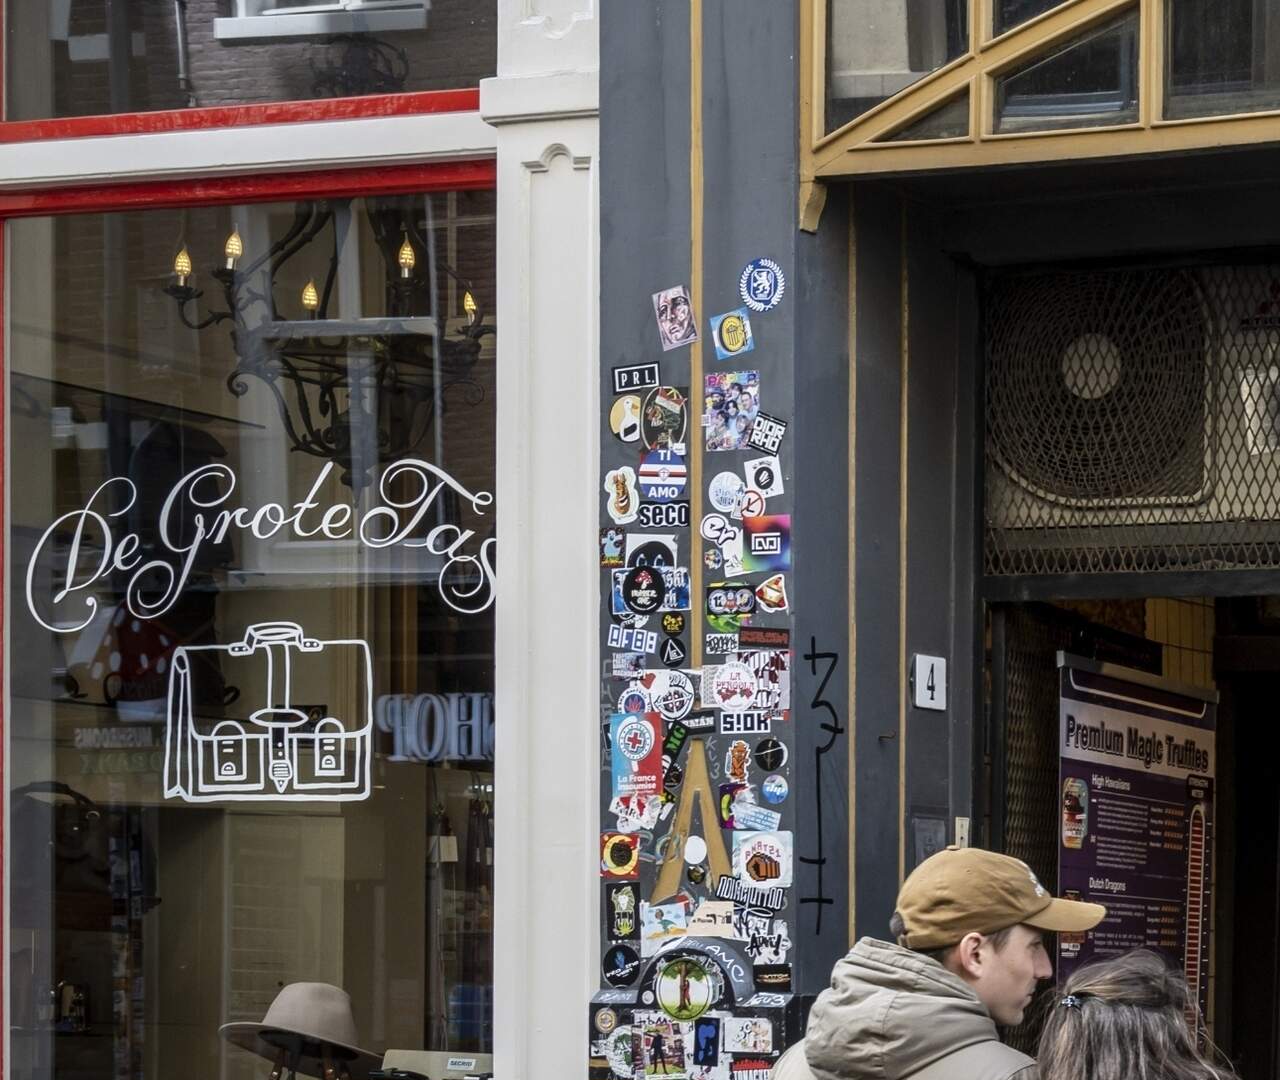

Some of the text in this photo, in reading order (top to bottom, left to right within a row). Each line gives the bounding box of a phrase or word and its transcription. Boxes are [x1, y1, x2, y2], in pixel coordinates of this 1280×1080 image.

[648, 486, 679, 499] AMO
[25, 476, 143, 635] De
[126, 462, 354, 621] Grote
[925, 662, 938, 701] 4
[1065, 714, 1210, 773] Premium Magic Truffles
[618, 774, 656, 783] La France
[1092, 774, 1104, 787] High
[1089, 877, 1126, 894] Dutch Dragons
